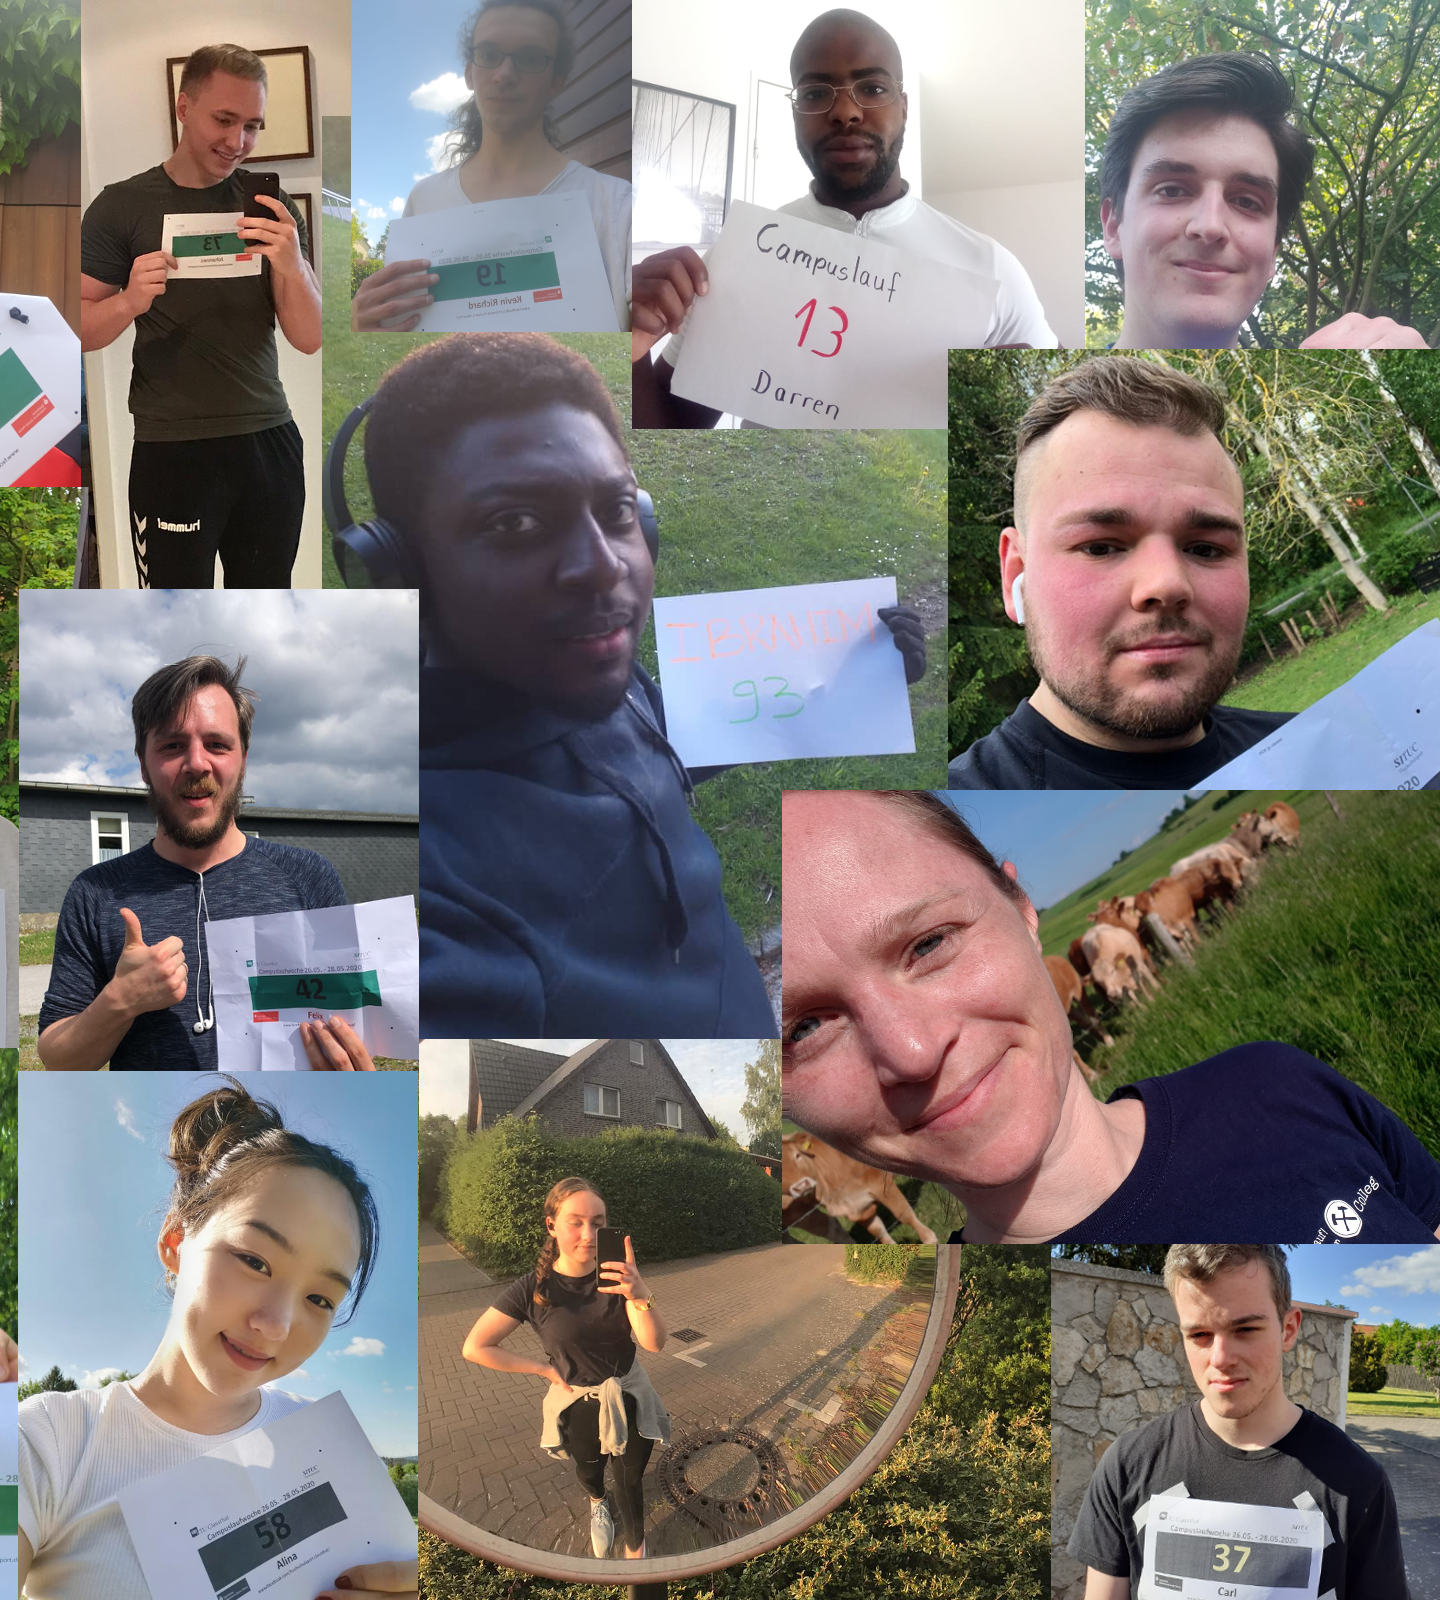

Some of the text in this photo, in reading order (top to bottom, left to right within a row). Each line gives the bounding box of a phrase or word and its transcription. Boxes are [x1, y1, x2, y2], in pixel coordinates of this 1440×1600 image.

[756, 224, 901, 302] Campuslauf
[795, 298, 848, 358] 13
[751, 369, 840, 420] Darren
[665, 602, 876, 662] IBRAHIM
[729, 676, 804, 724] 93
[1393, 742, 1420, 769] SITUC
[304, 966, 322, 974] 26.05.
[296, 978, 326, 1000] 42
[308, 1011, 324, 1020] Felix
[1354, 1176, 1380, 1212] Colleg
[6, 1474, 18, 1483] 28
[206, 1509, 262, 1542] Campuslaufwoche
[282, 1480, 316, 1501] 28.05.2020
[254, 1512, 292, 1550] 58
[1170, 1525, 1298, 1544] Campuslaufwoche 26.05. 28.05.2020
[276, 1552, 298, 1570] Alina
[1212, 1544, 1251, 1573] 37
[1218, 1586, 1237, 1598] Carl
